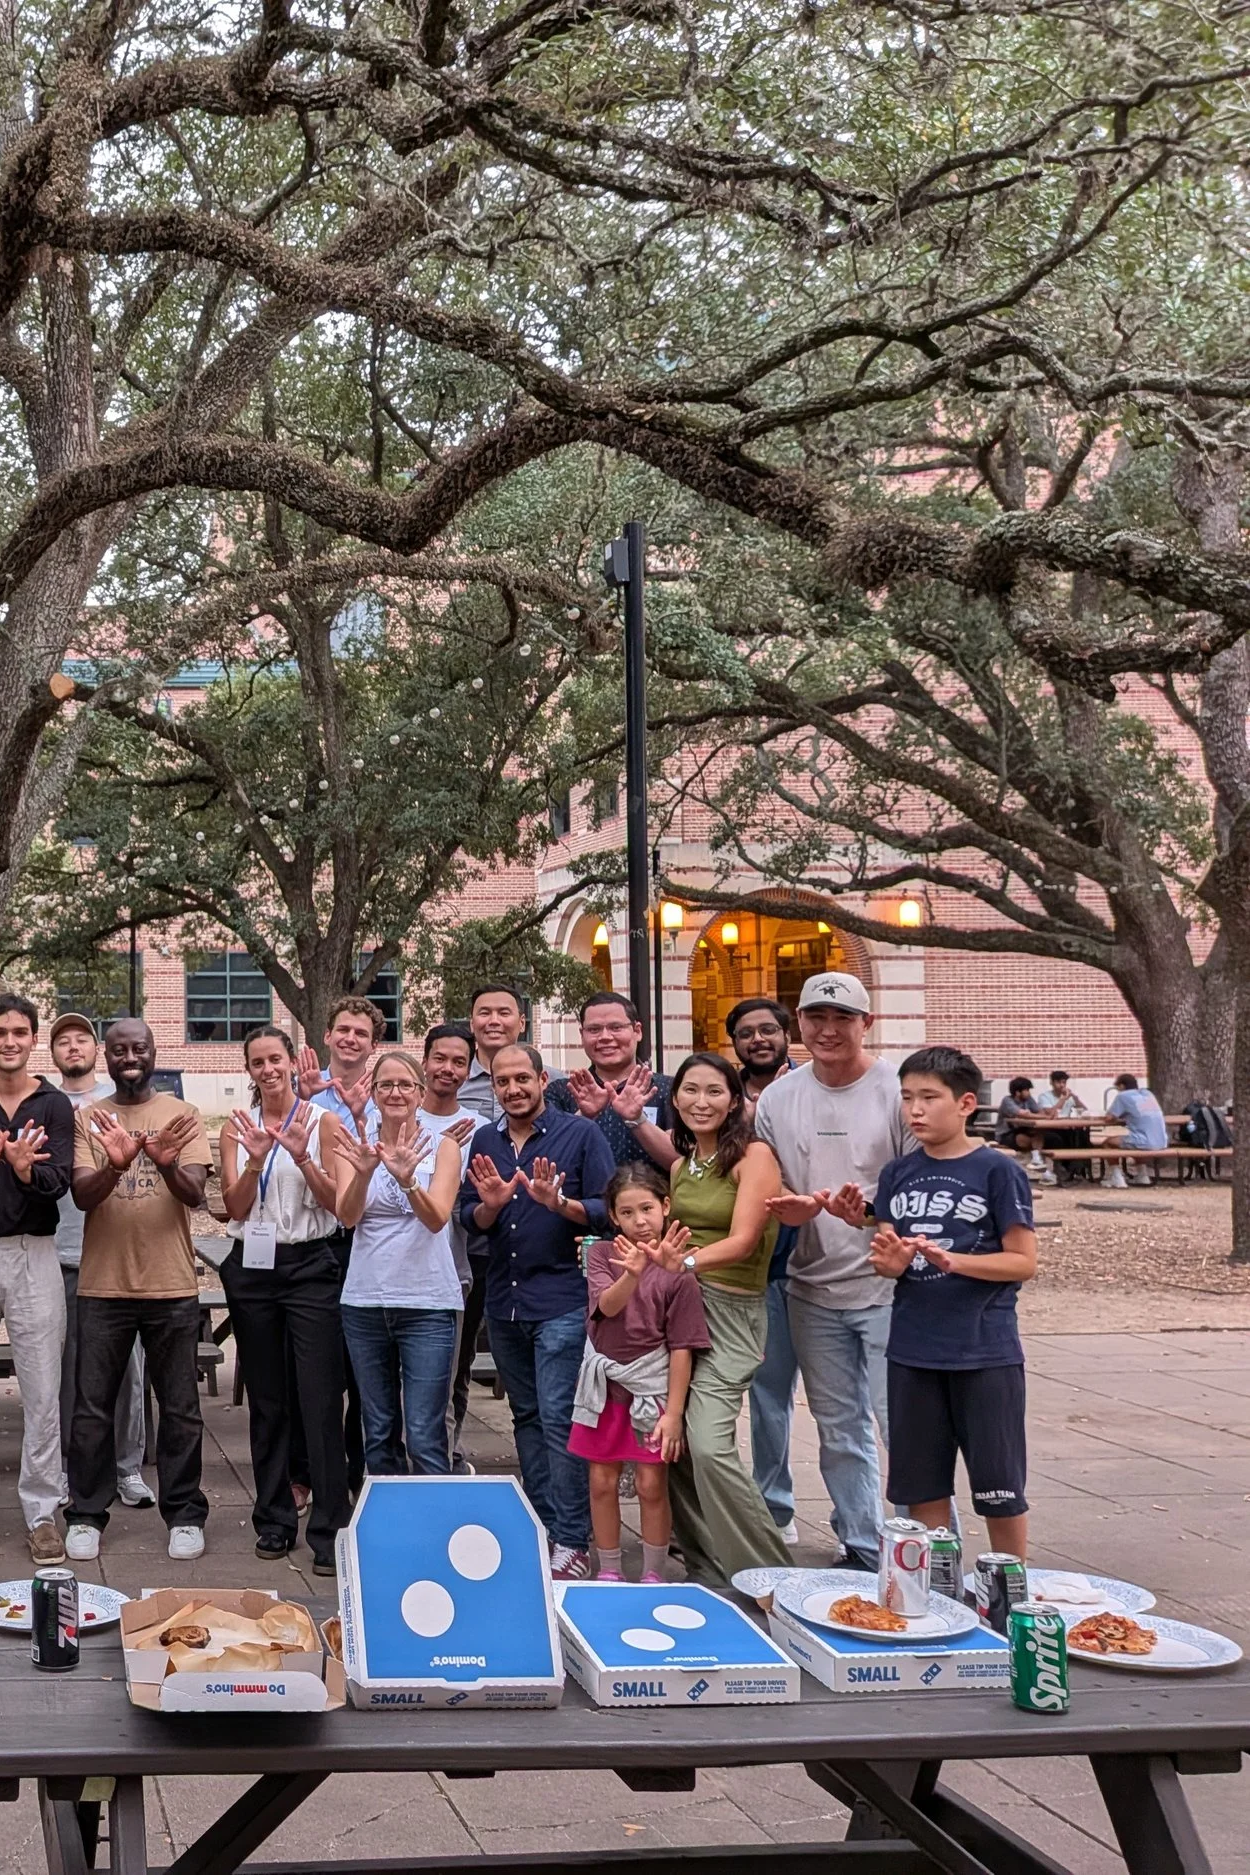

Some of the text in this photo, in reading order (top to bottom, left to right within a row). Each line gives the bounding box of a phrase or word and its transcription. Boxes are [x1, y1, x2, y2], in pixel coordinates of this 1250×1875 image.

[58, 1586, 78, 1648] 7UP
[431, 1655, 486, 1668] Domino's
[1026, 1615, 1067, 1711] Sprite
[847, 1666, 900, 1682] SMALL
[612, 1681, 667, 1697] SMALL
[370, 1692, 425, 1704] SMALL
